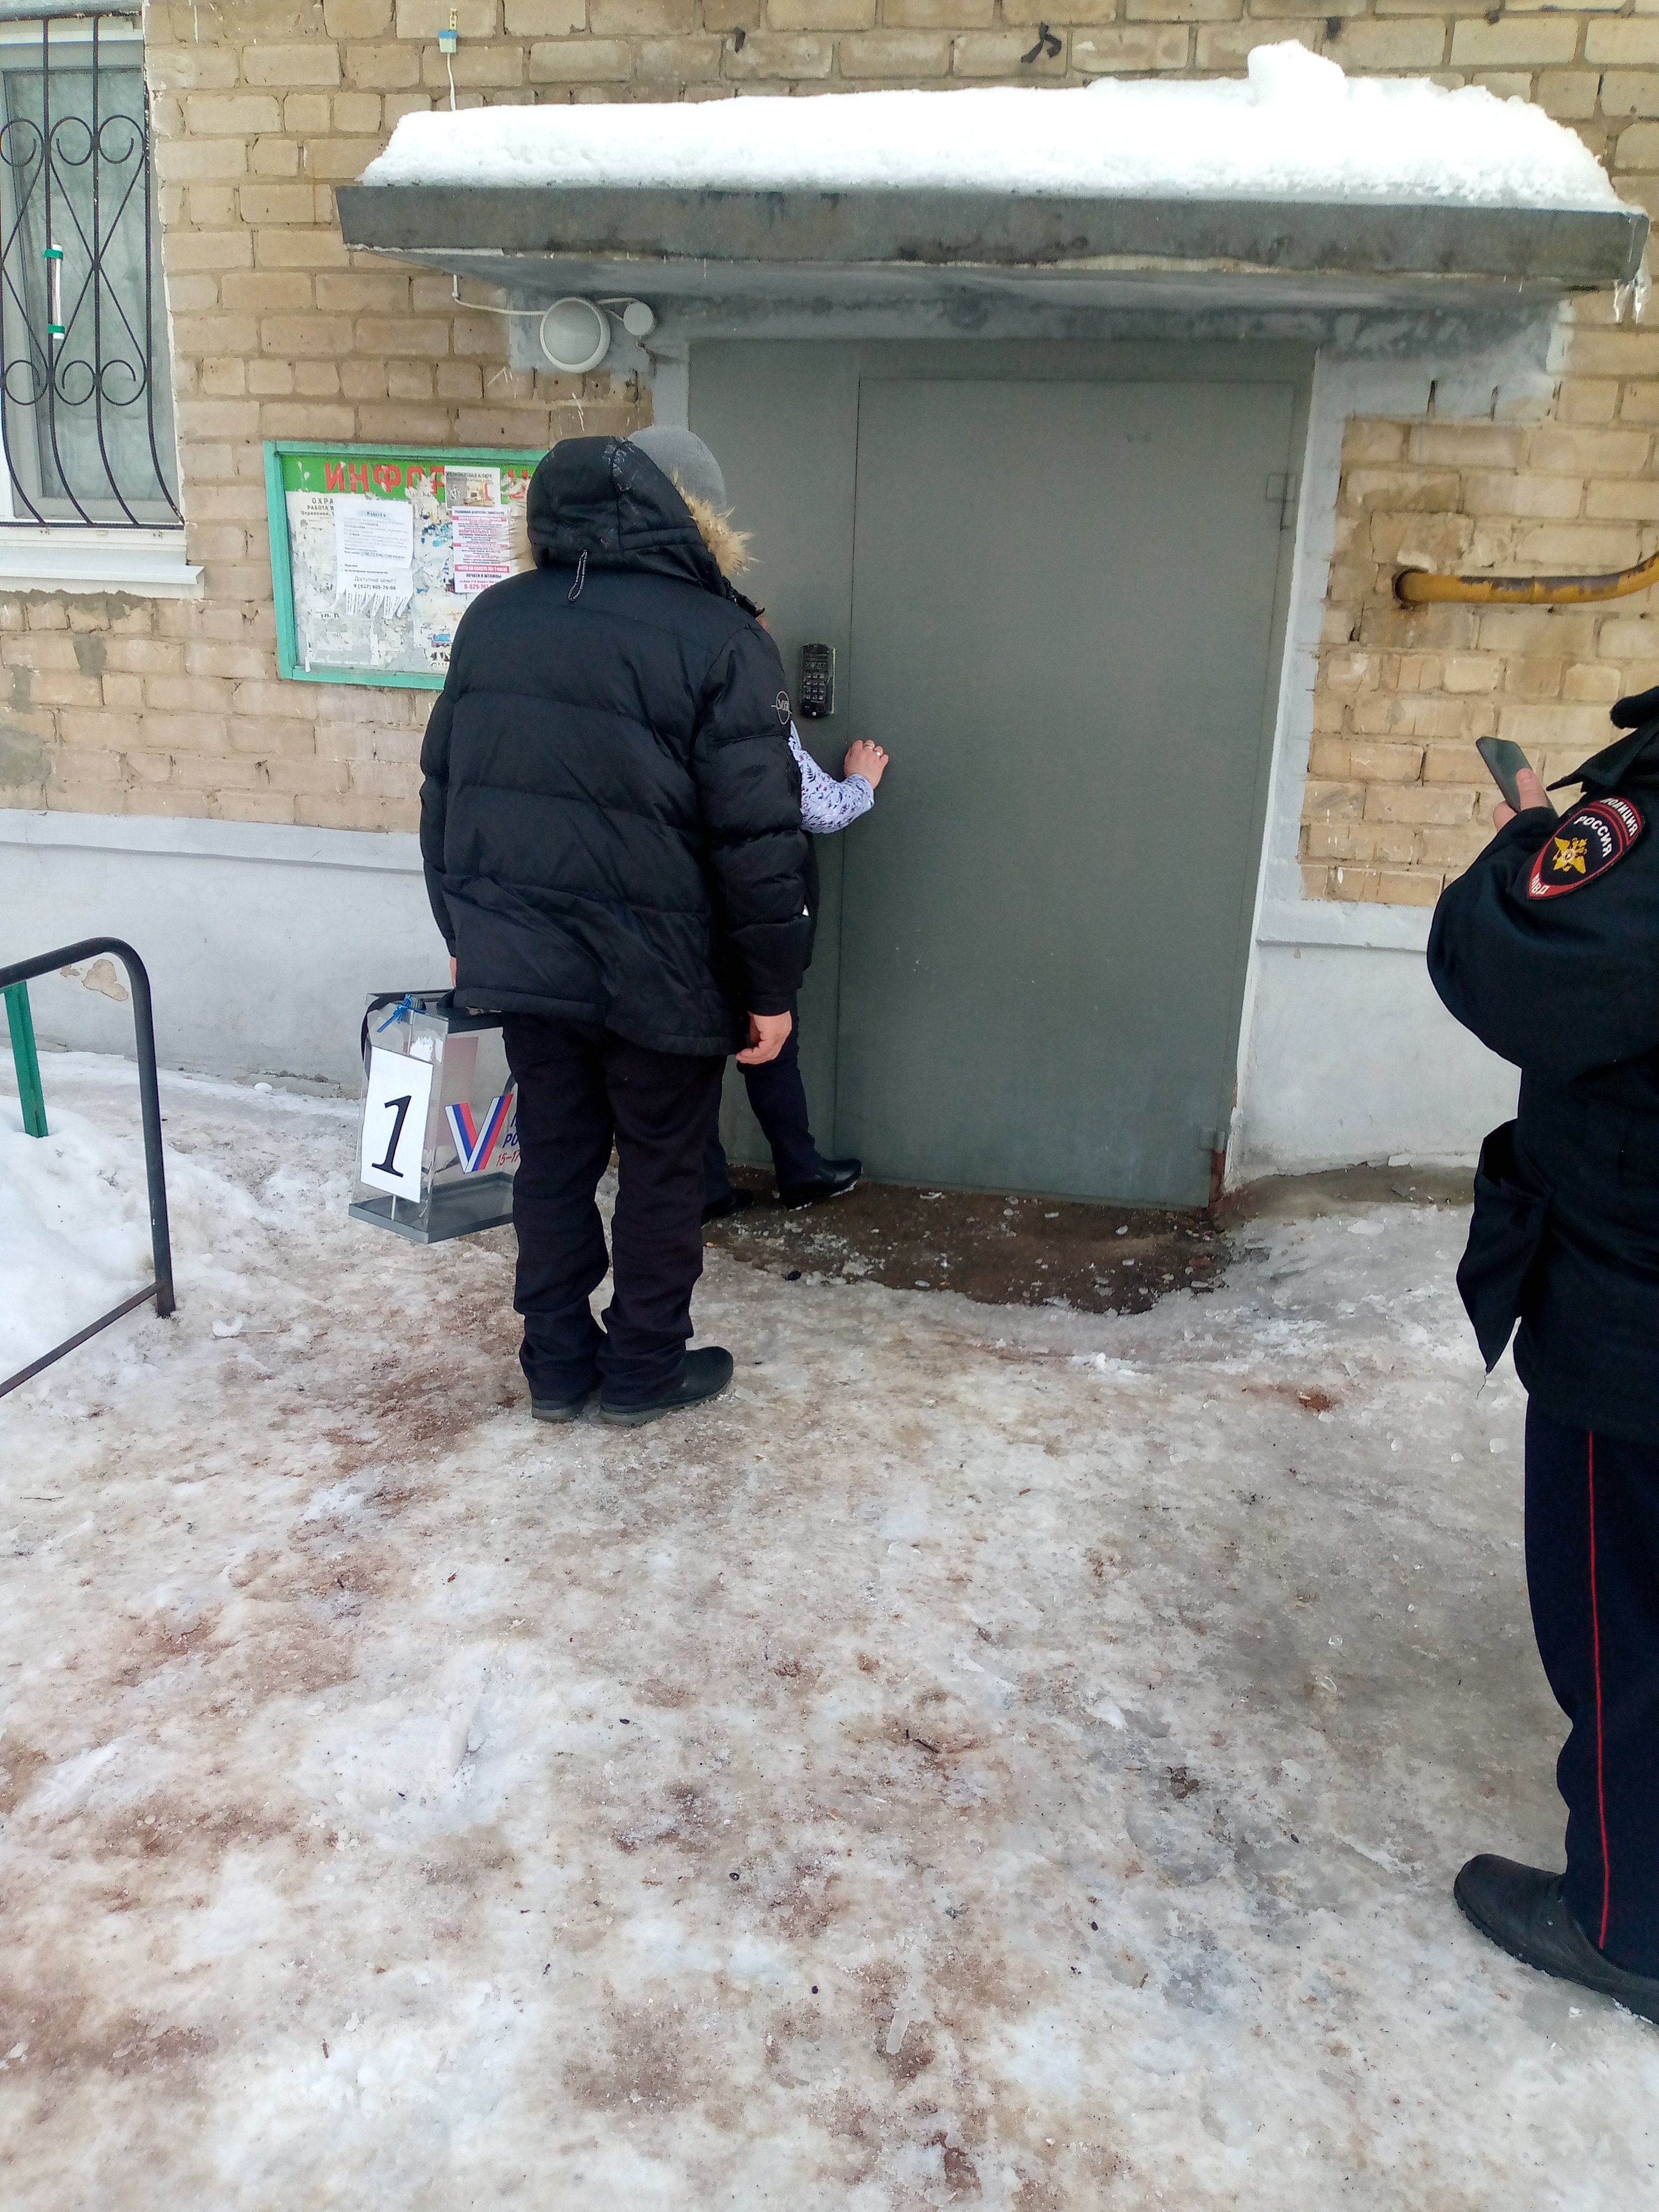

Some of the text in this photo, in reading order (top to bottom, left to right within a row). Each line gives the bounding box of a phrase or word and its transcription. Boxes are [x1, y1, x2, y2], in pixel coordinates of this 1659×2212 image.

[1573, 816, 1612, 858] РОССИЯ
[1599, 798, 1638, 836] ПОЛИЦИЯ
[1531, 873, 1550, 894] МВД
[371, 1095, 412, 1178] 1
